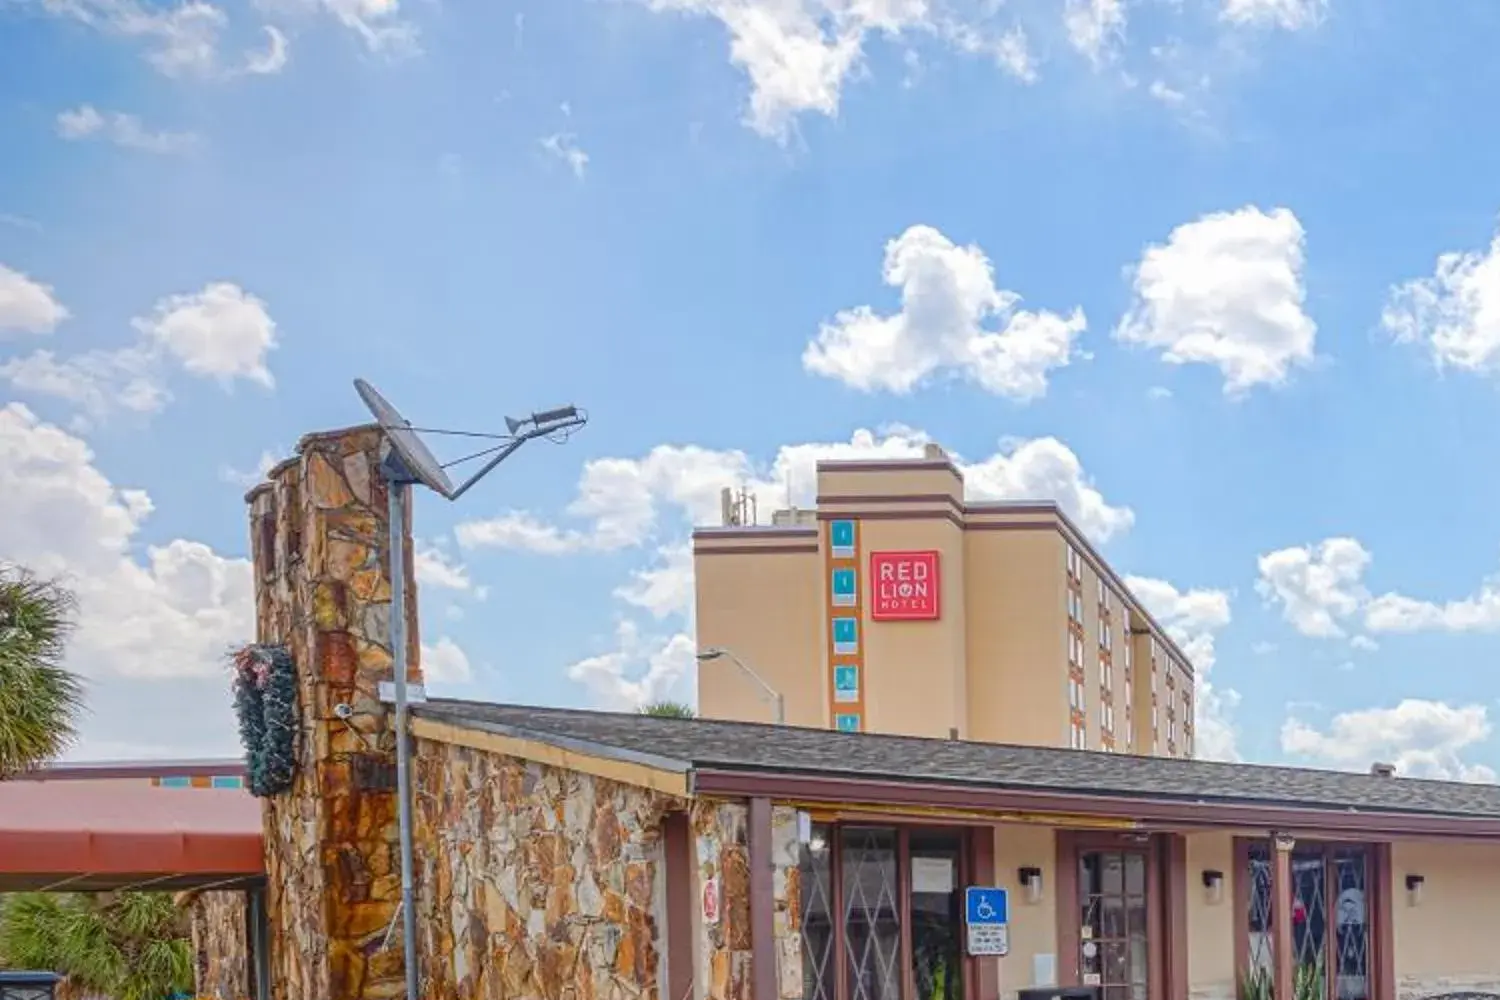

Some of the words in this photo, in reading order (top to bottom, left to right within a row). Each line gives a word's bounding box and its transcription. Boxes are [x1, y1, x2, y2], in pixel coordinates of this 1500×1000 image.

[881, 561, 927, 580] RED
[881, 582, 927, 599] LION
[881, 599, 927, 609] HOTEL
